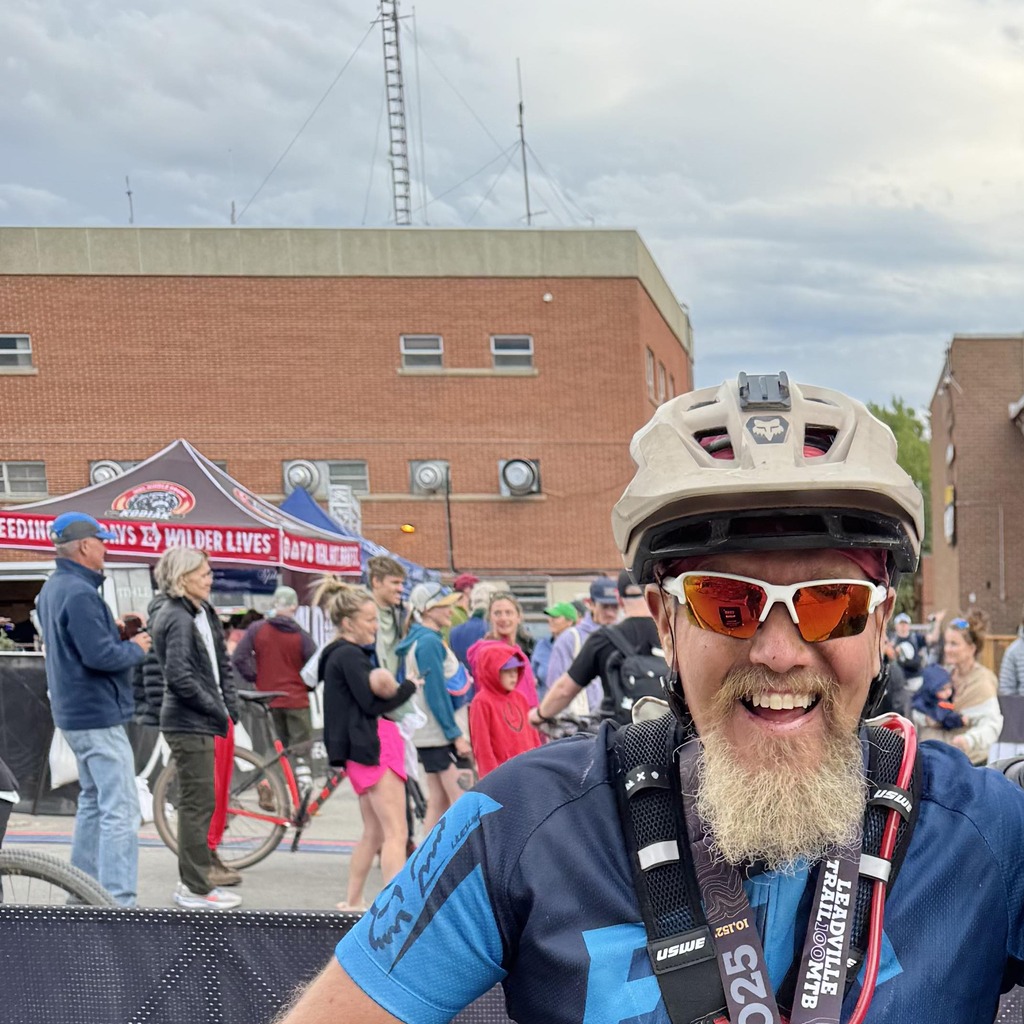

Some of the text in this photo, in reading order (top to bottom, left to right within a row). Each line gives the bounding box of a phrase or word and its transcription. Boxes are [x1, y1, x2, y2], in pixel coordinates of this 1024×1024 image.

[164, 526, 223, 552] WILDER
[873, 789, 913, 813] USWE
[656, 937, 706, 961] USWE
[820, 878, 852, 996] LEADVILLE
